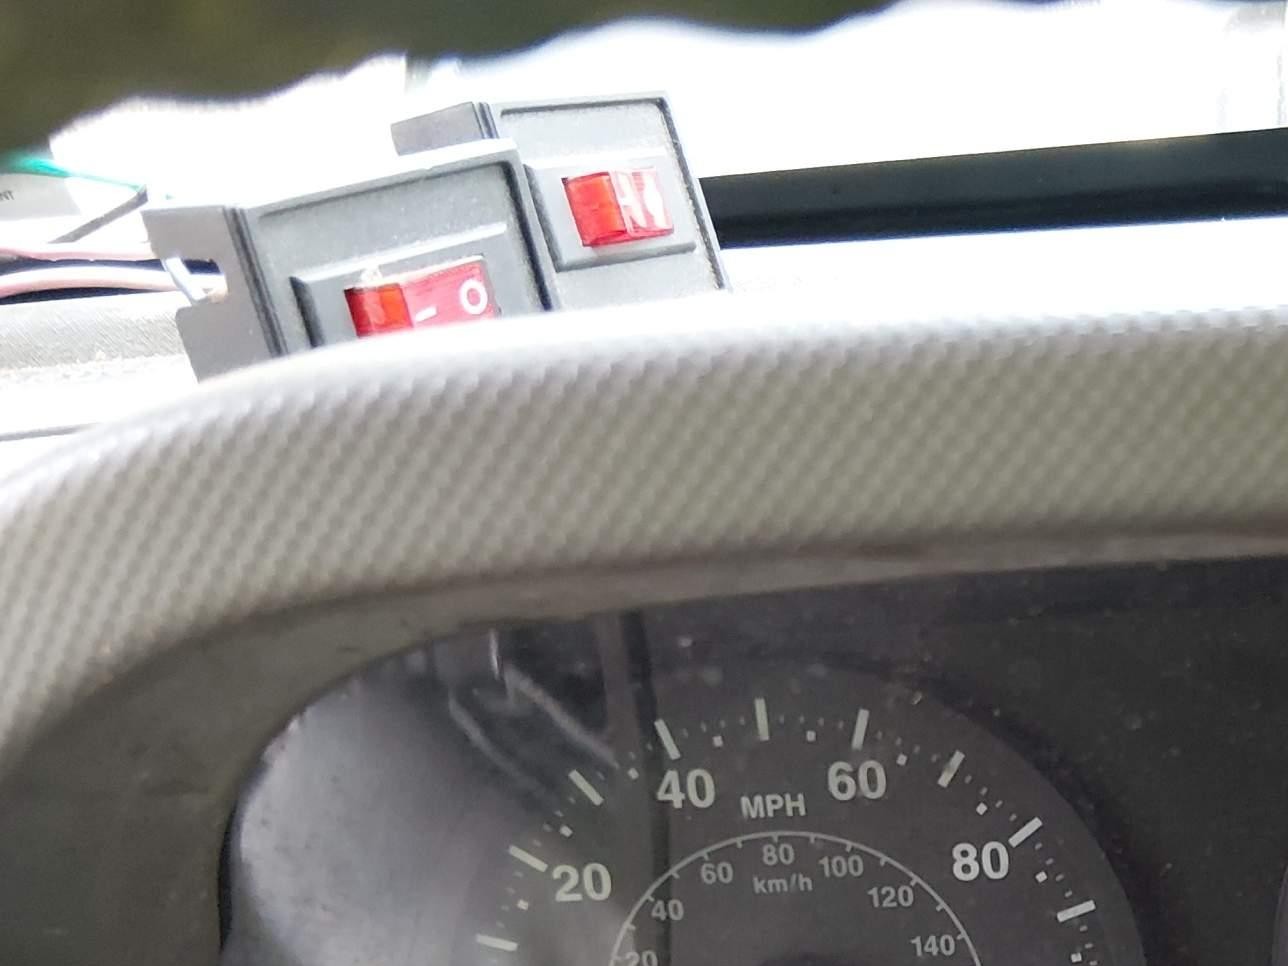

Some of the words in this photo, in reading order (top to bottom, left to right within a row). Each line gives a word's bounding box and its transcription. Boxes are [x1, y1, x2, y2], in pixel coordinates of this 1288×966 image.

[657, 768, 715, 809] 40
[827, 759, 887, 801] 60
[740, 793, 806, 819] MPH
[762, 843, 796, 866] 80
[818, 854, 864, 878] 100
[951, 841, 1010, 882] 80
[552, 862, 612, 902] 20
[700, 861, 734, 886] 60
[753, 873, 814, 895] km/h
[867, 884, 915, 909] 120
[651, 898, 685, 921] 40
[910, 934, 956, 957] 140
